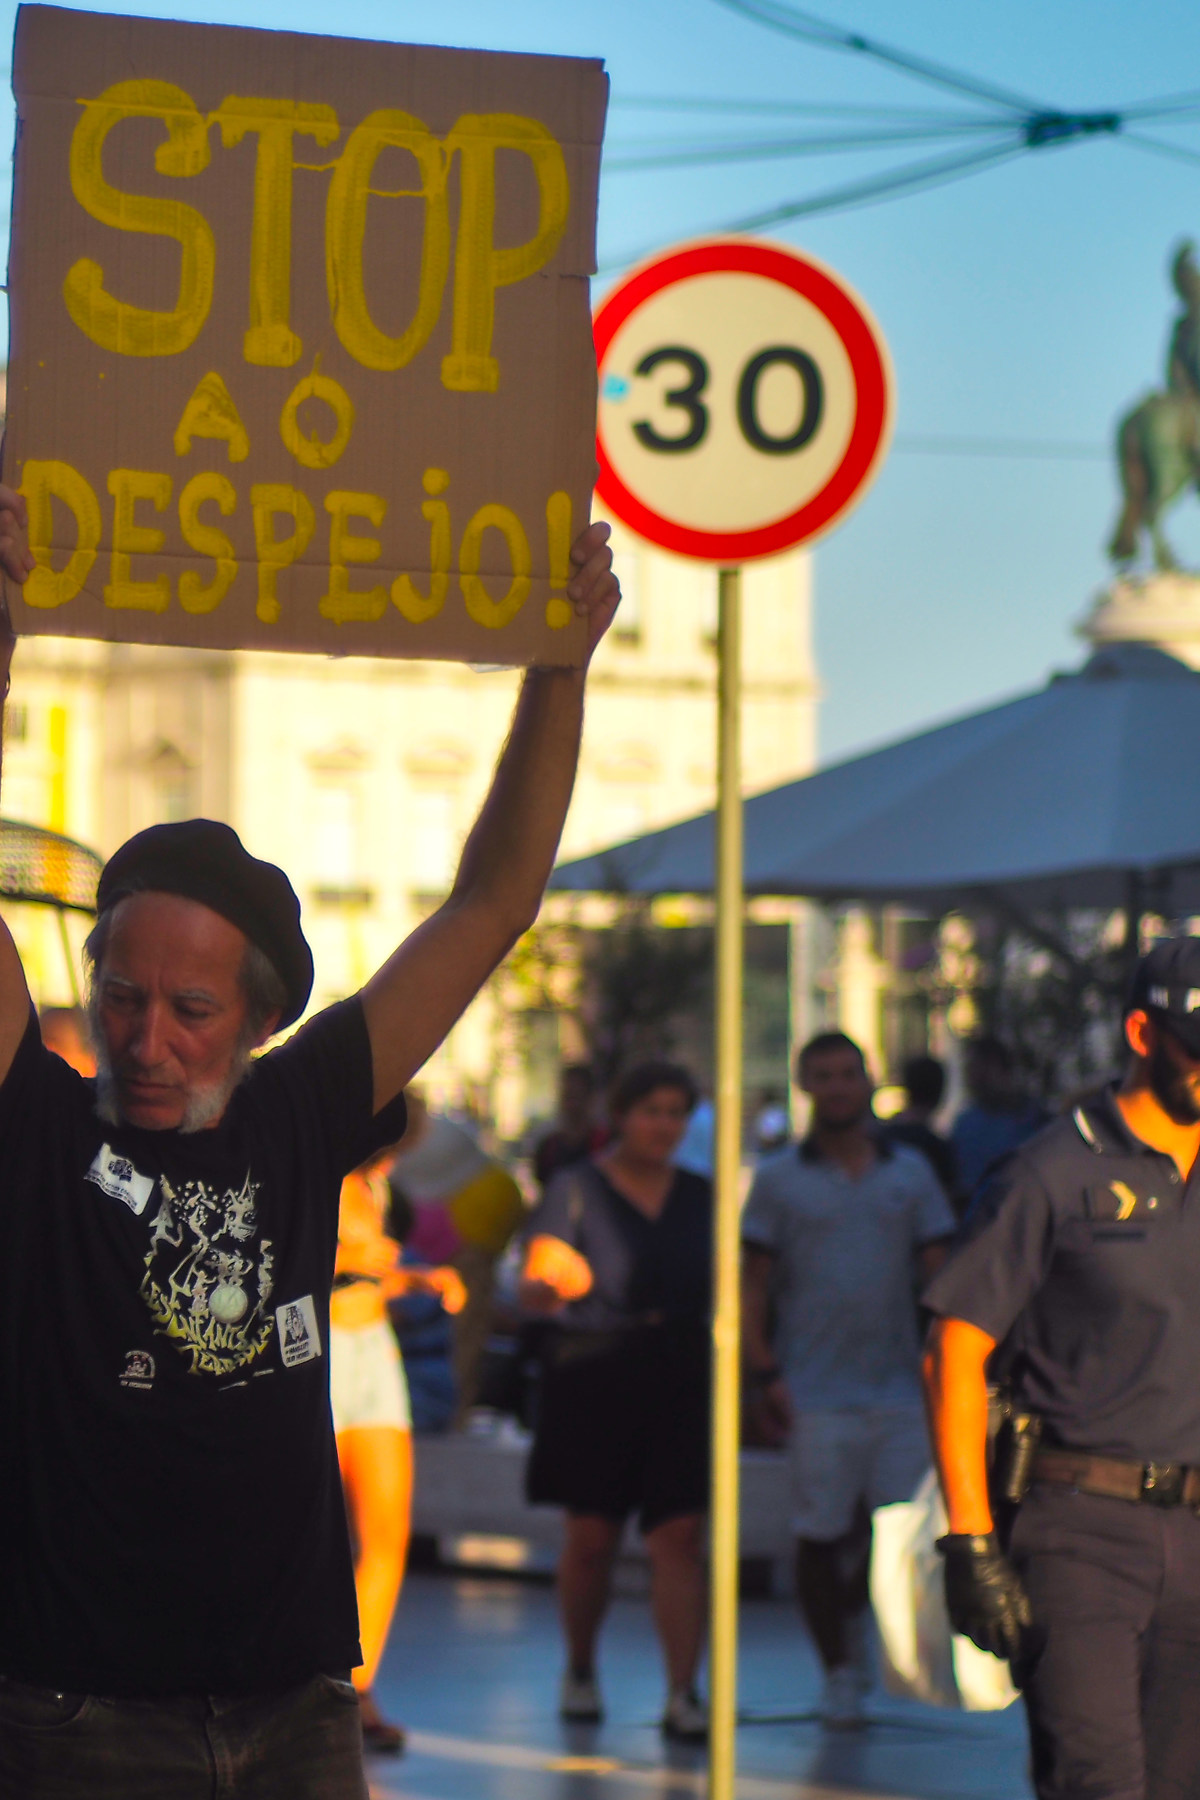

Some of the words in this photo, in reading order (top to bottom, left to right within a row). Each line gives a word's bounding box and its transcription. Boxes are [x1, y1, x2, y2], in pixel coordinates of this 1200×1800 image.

[62, 78, 570, 394] STOP
[173, 352, 357, 470] AO
[632, 346, 824, 455] 30
